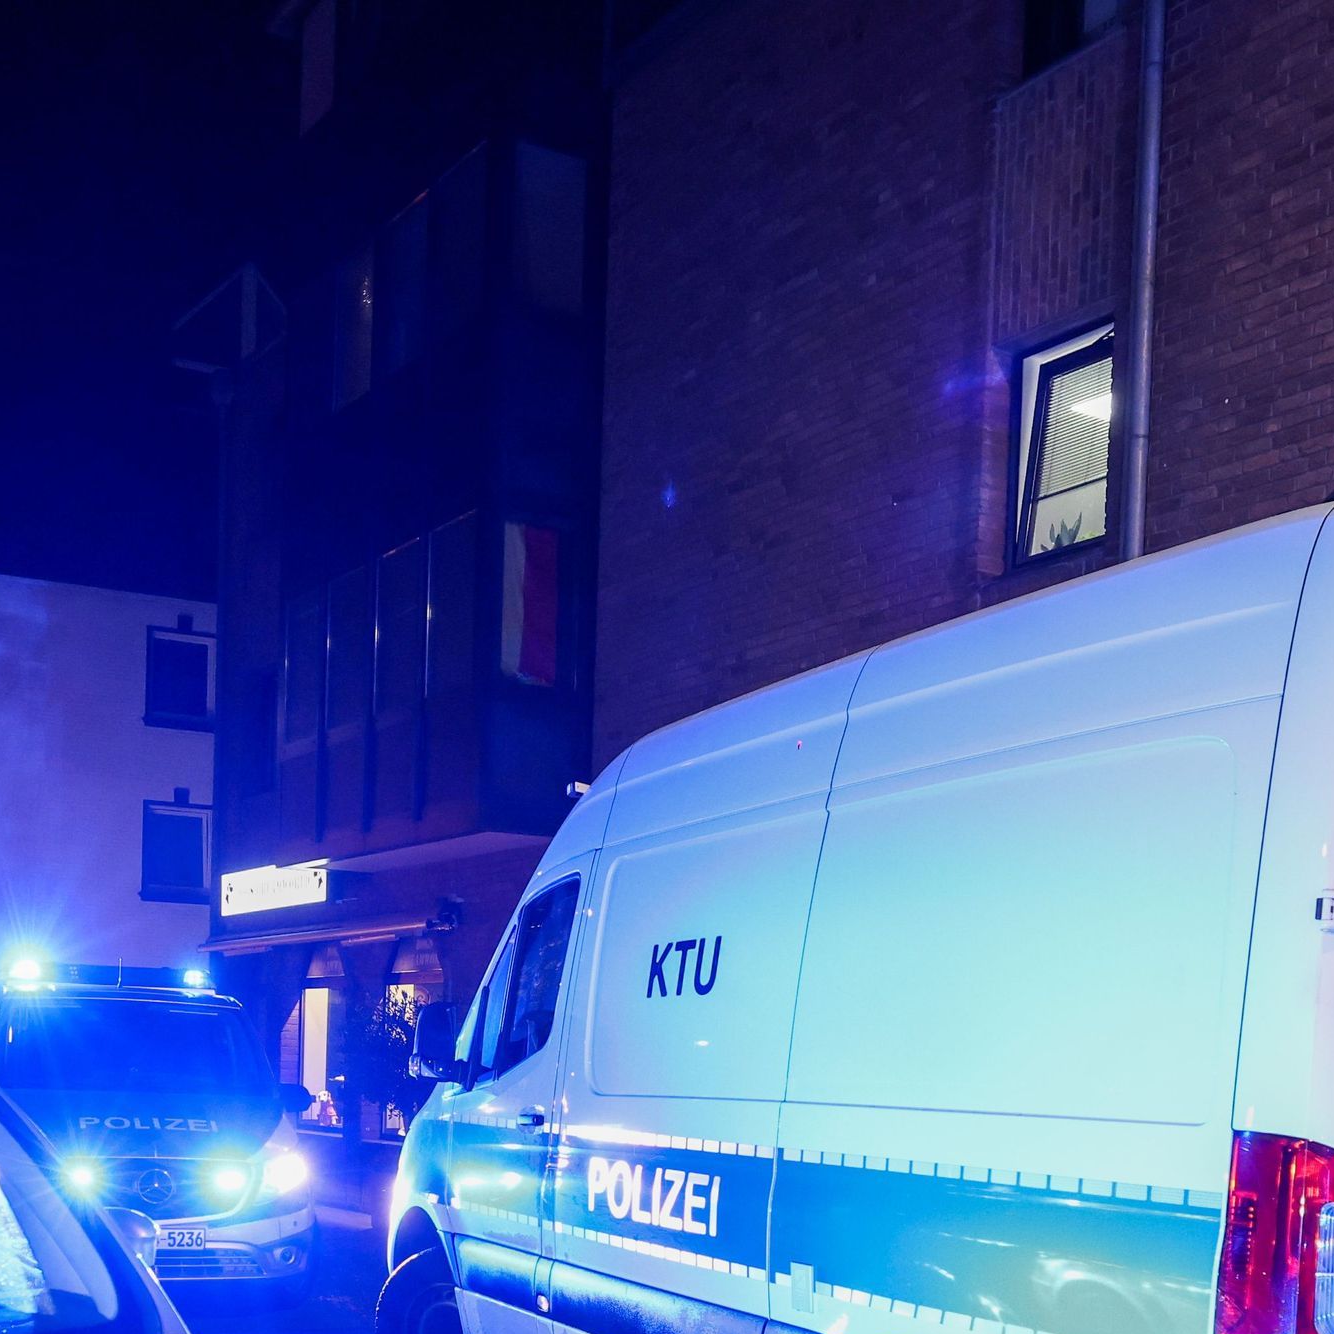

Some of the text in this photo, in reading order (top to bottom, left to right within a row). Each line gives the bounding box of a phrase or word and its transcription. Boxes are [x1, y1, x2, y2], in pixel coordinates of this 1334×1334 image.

[646, 935, 723, 999] KTU
[79, 1116, 219, 1133] POLIZEI
[587, 1156, 721, 1238] POLIZEI
